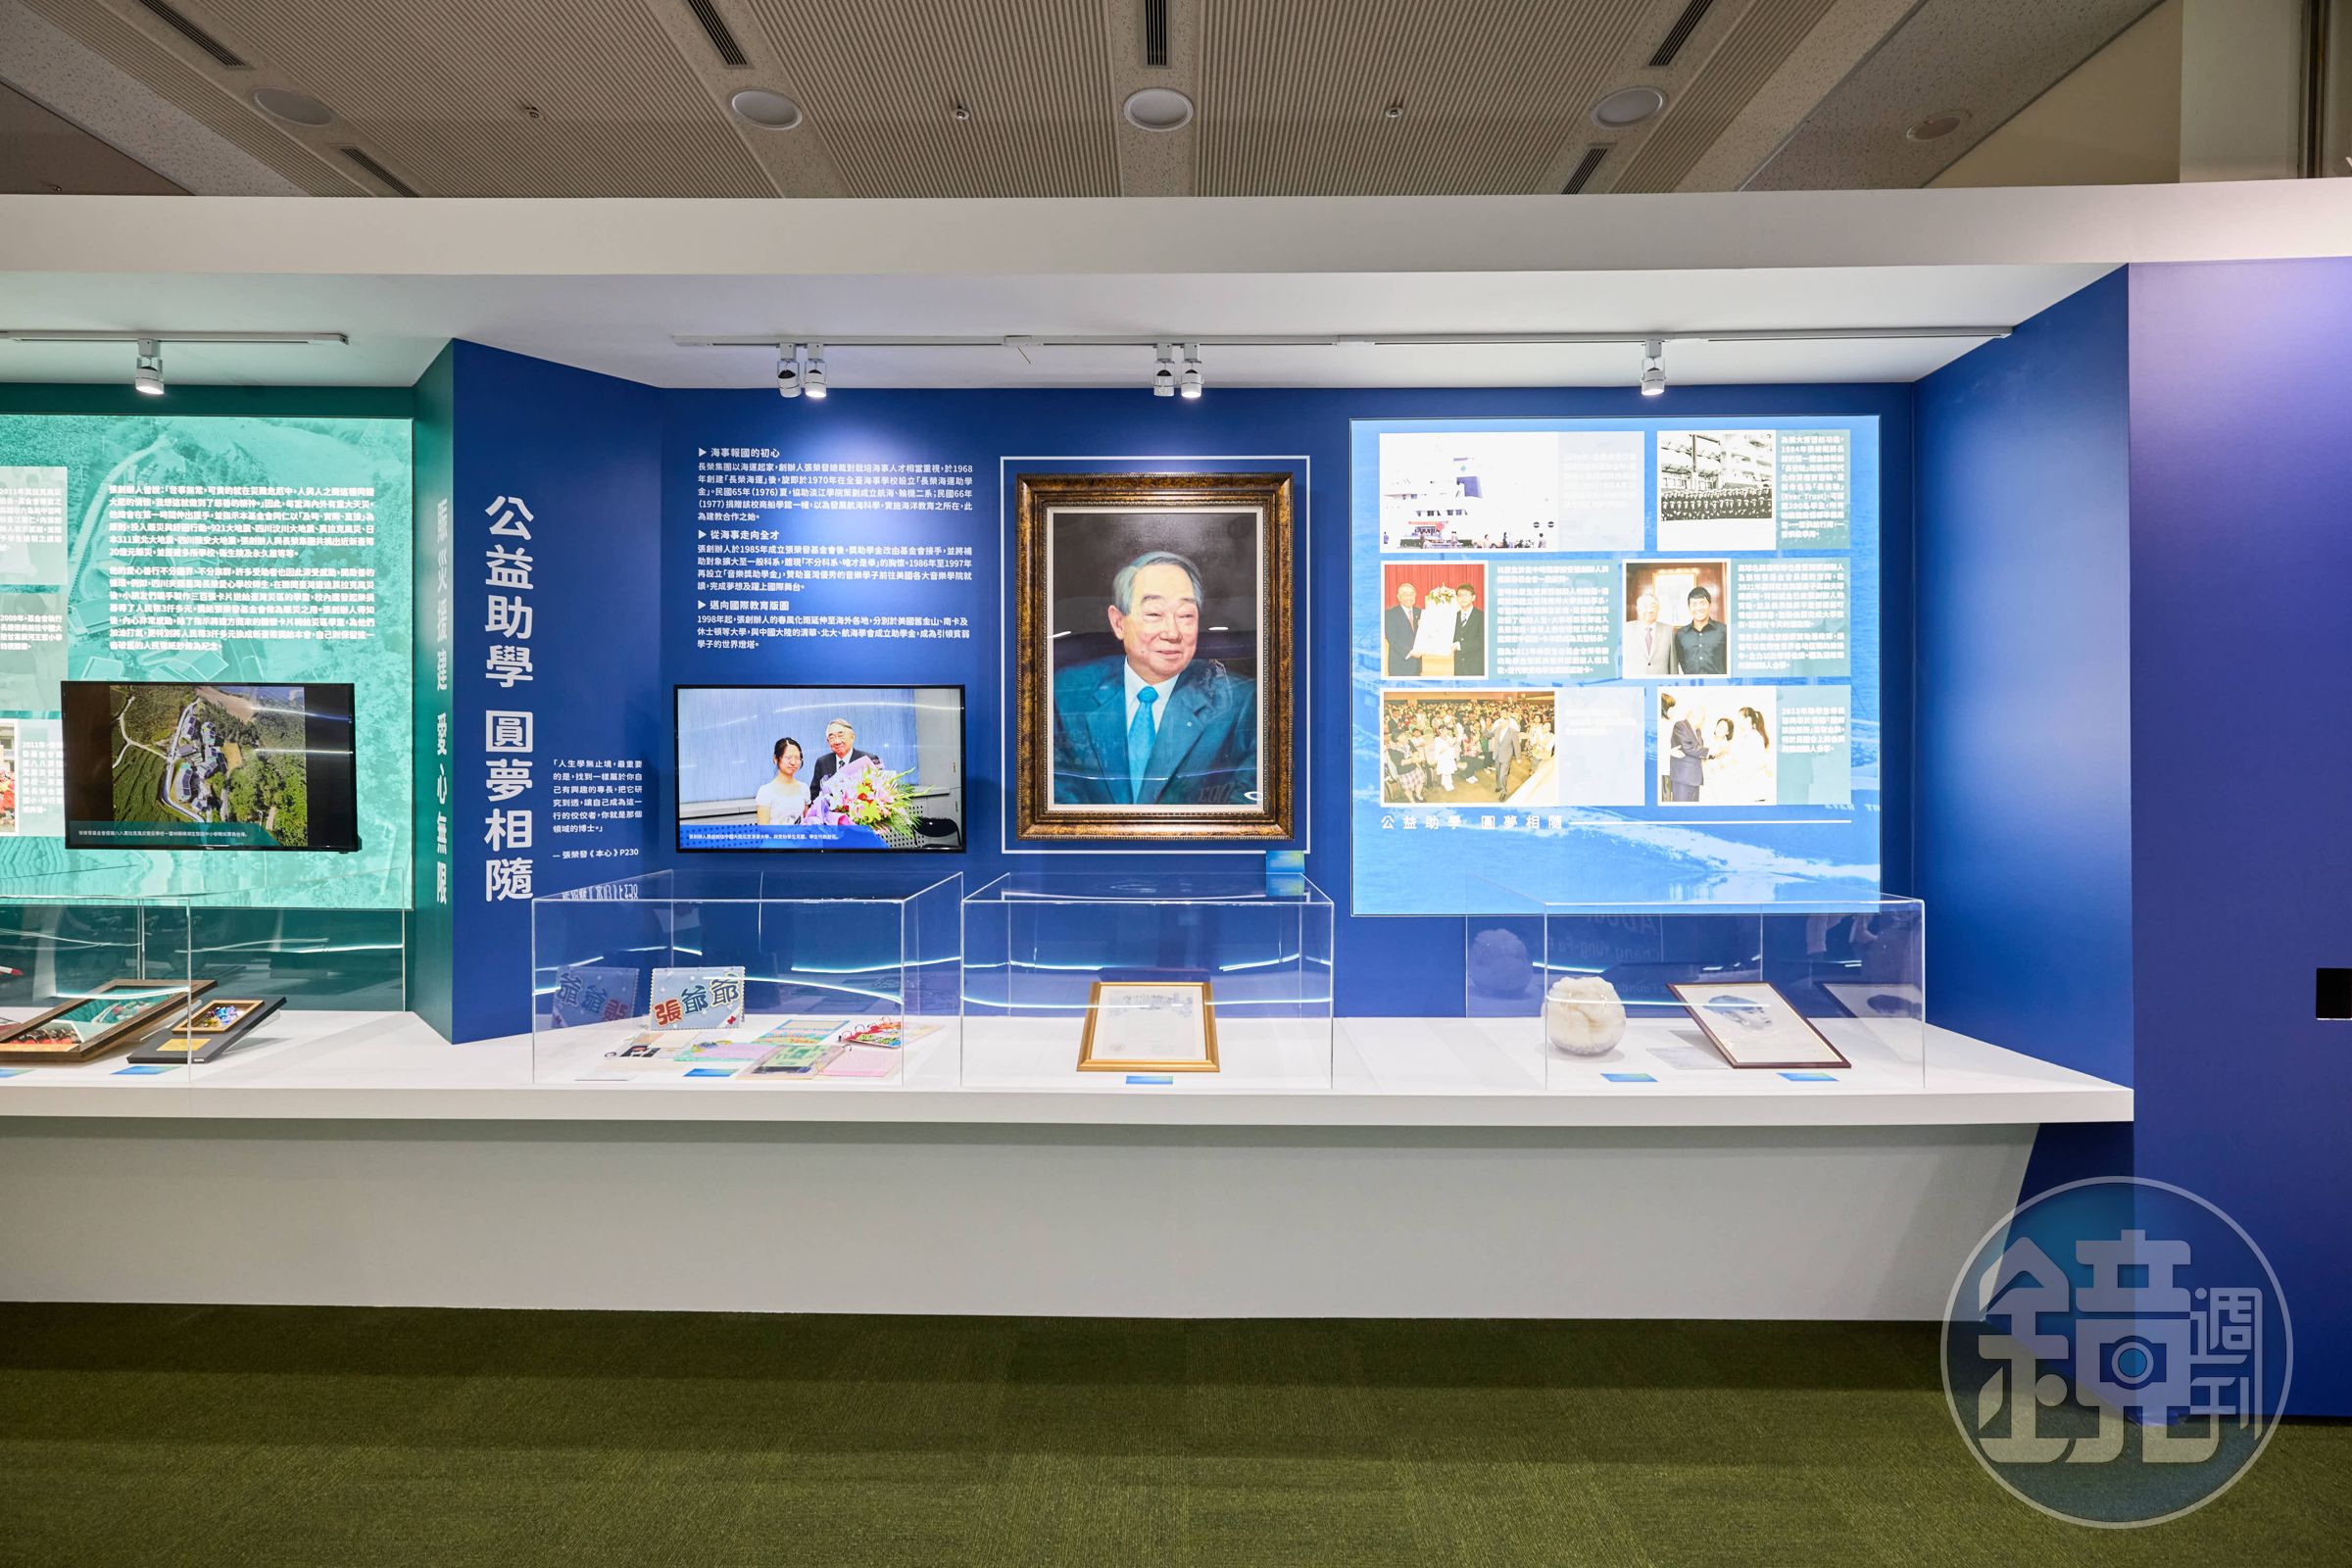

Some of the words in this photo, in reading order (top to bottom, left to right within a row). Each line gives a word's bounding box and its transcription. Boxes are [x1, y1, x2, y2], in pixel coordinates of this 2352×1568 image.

[710, 448, 780, 458] 海事報國的初心
[710, 530, 779, 540] 從海事走向全才
[436, 499, 448, 691] 賑災援建
[484, 495, 533, 687] 公益助學
[710, 601, 790, 611] 邁向國際教育版圖
[698, 640, 759, 649] 學子的世界燈塔。
[554, 760, 642, 768] 「人生學無止境，最重要
[436, 712, 448, 905] 愛心無限
[484, 710, 533, 903] 圓夢相隨
[1381, 815, 1461, 829] 公益助學
[1481, 815, 1562, 829] 圓夢相隨
[654, 974, 741, 1026] 張爺爺
